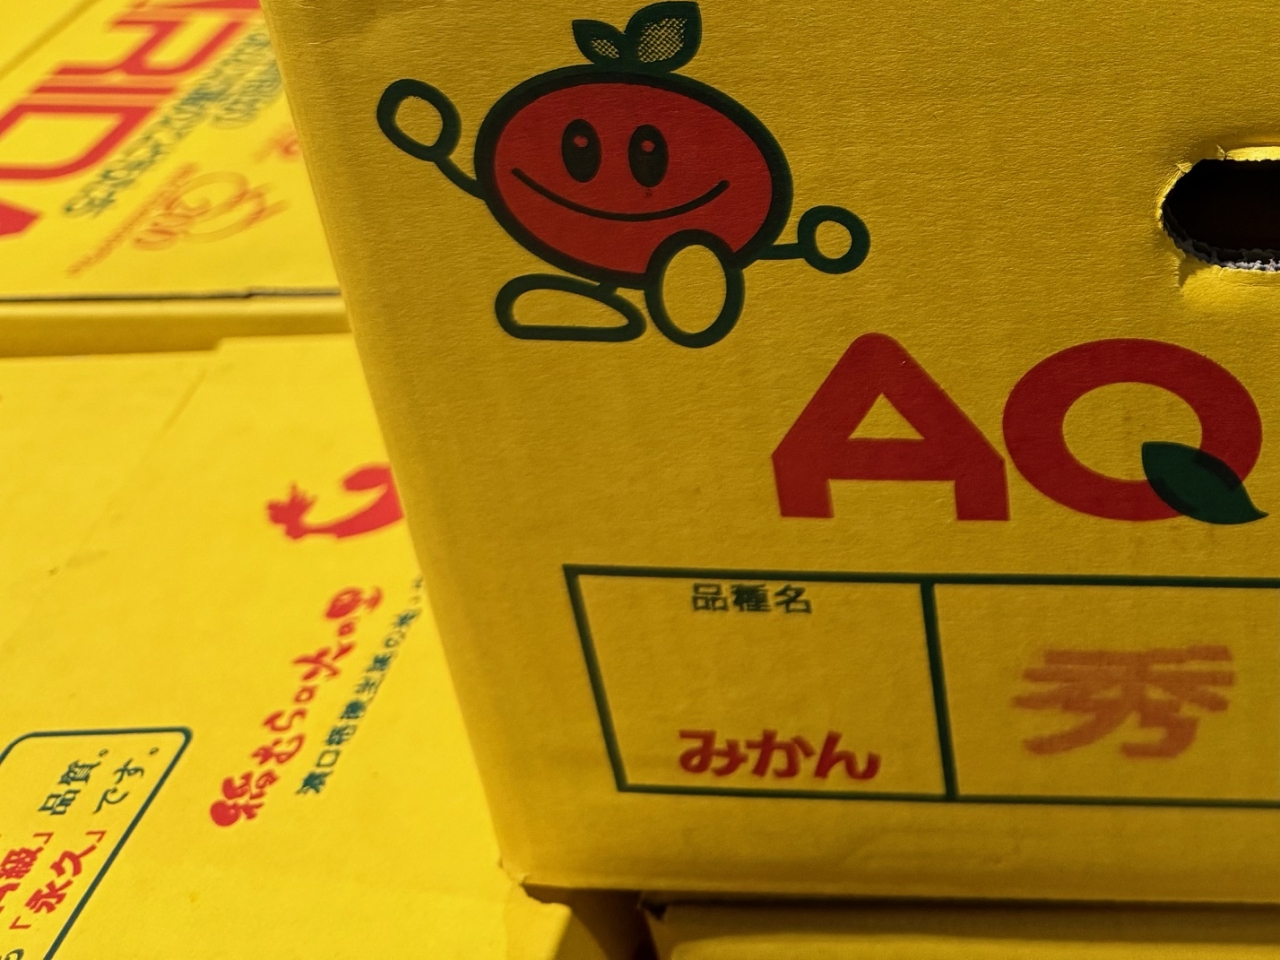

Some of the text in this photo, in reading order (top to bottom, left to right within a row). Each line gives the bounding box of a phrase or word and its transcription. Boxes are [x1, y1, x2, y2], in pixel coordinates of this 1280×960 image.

[772, 334, 1267, 526] AQ
[691, 584, 813, 615] 品種名
[1013, 644, 1236, 759] 秀
[680, 730, 880, 781] みかん
